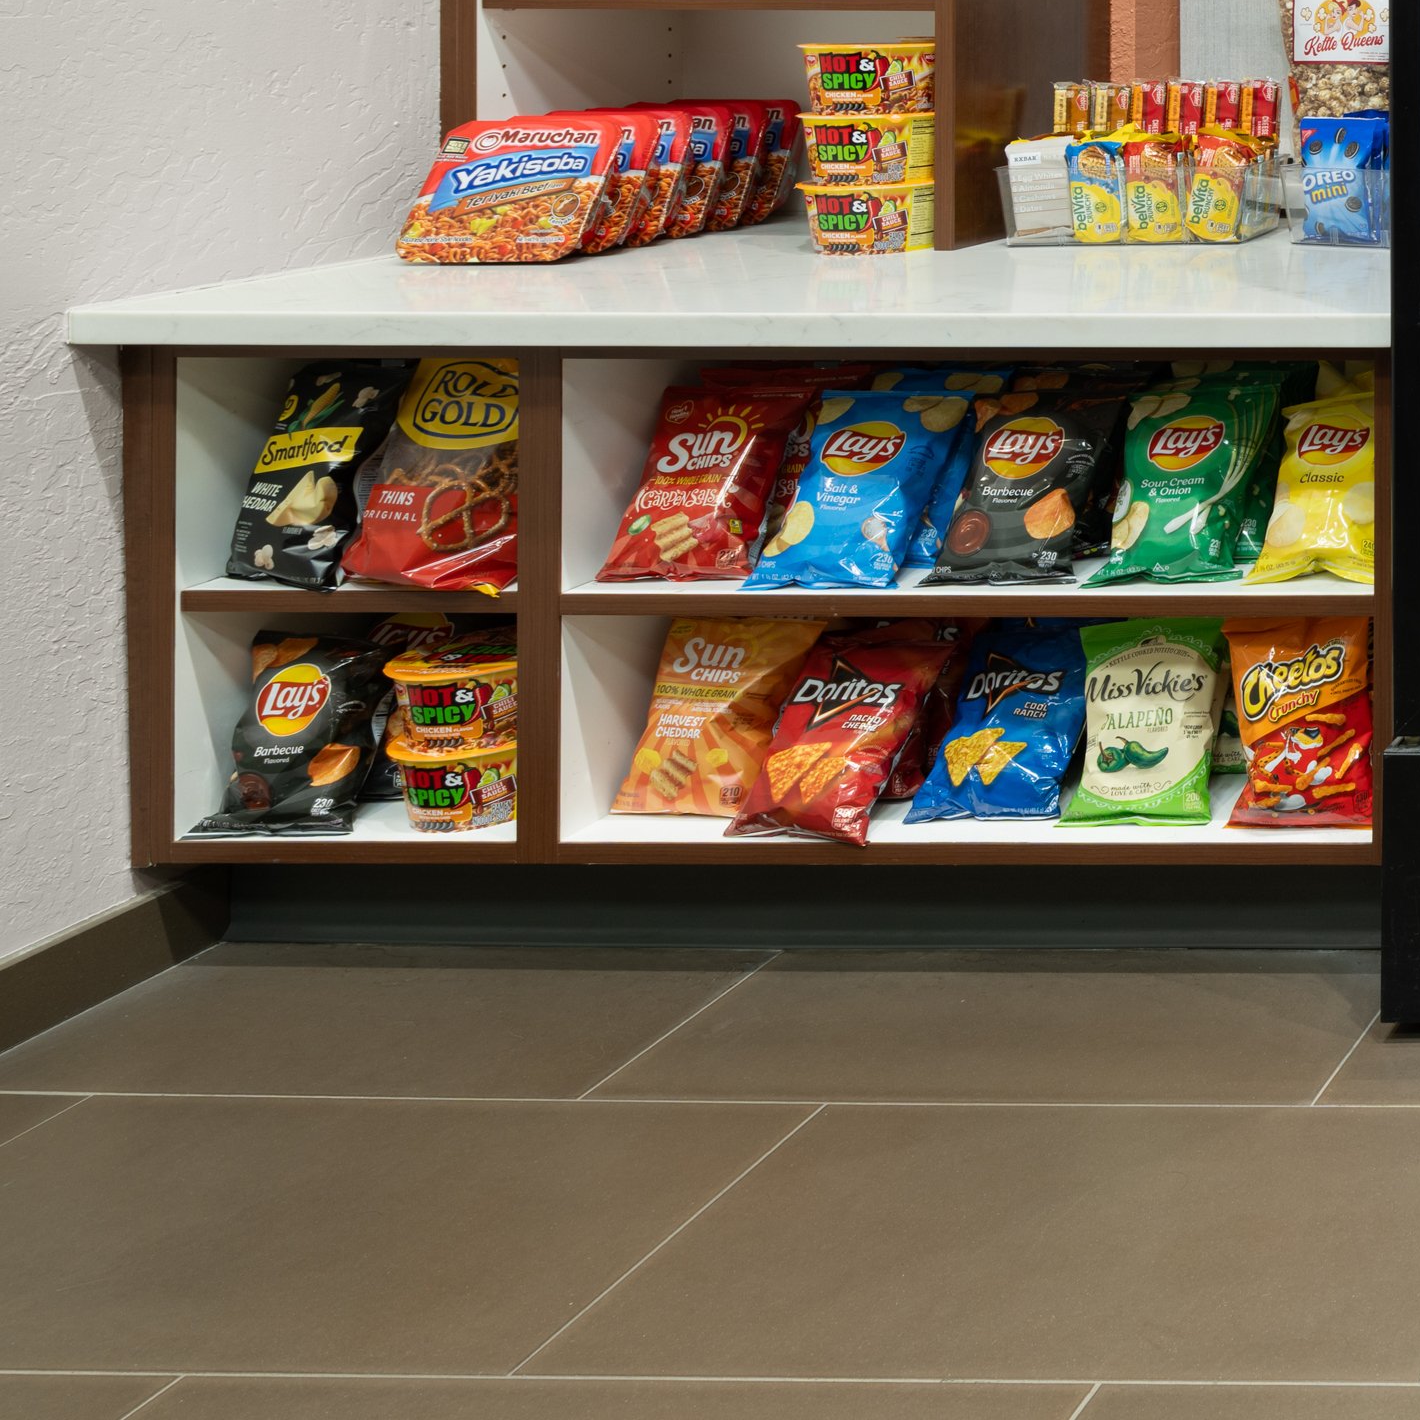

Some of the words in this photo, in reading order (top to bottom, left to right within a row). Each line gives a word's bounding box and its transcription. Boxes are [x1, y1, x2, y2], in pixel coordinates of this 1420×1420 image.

[1305, 34, 1337, 56] Kettle
[1341, 33, 1384, 51] Queens
[820, 54, 857, 72] HOT
[859, 58, 873, 72] &
[823, 72, 876, 90] SPICY
[456, 155, 587, 193] Yakisoba
[465, 188, 521, 210] Teriyaki
[523, 182, 547, 195] Beef
[421, 399, 506, 428] GOLD
[261, 435, 350, 467] Smartfood
[830, 433, 899, 463] Lay's
[1141, 479, 1166, 489] Sour
[1169, 477, 1205, 487] Cream
[1300, 472, 1344, 484] Classic
[252, 481, 282, 496] WHITE
[824, 483, 849, 493] Salt
[1149, 487, 1157, 496] &
[1159, 486, 1191, 496] Onion
[379, 490, 415, 506] THINS
[816, 493, 861, 506] Vinegar
[363, 510, 417, 521] ORIGINAL
[691, 668, 742, 683] CHIPS
[1134, 662, 1204, 702] Vickie's
[656, 685, 680, 695] 100%
[681, 687, 708, 697] WHOLE
[710, 689, 738, 698] GRAIN
[793, 679, 902, 704] Doritos
[1012, 708, 1047, 718] RANCH
[1023, 701, 1048, 711] COOL
[1268, 690, 1319, 722] Crunchy
[659, 714, 707, 727] HARVEST
[1102, 707, 1173, 730] JALAPEÑO
[656, 727, 700, 738] CHEDDAR
[254, 744, 304, 758] Barbecue
